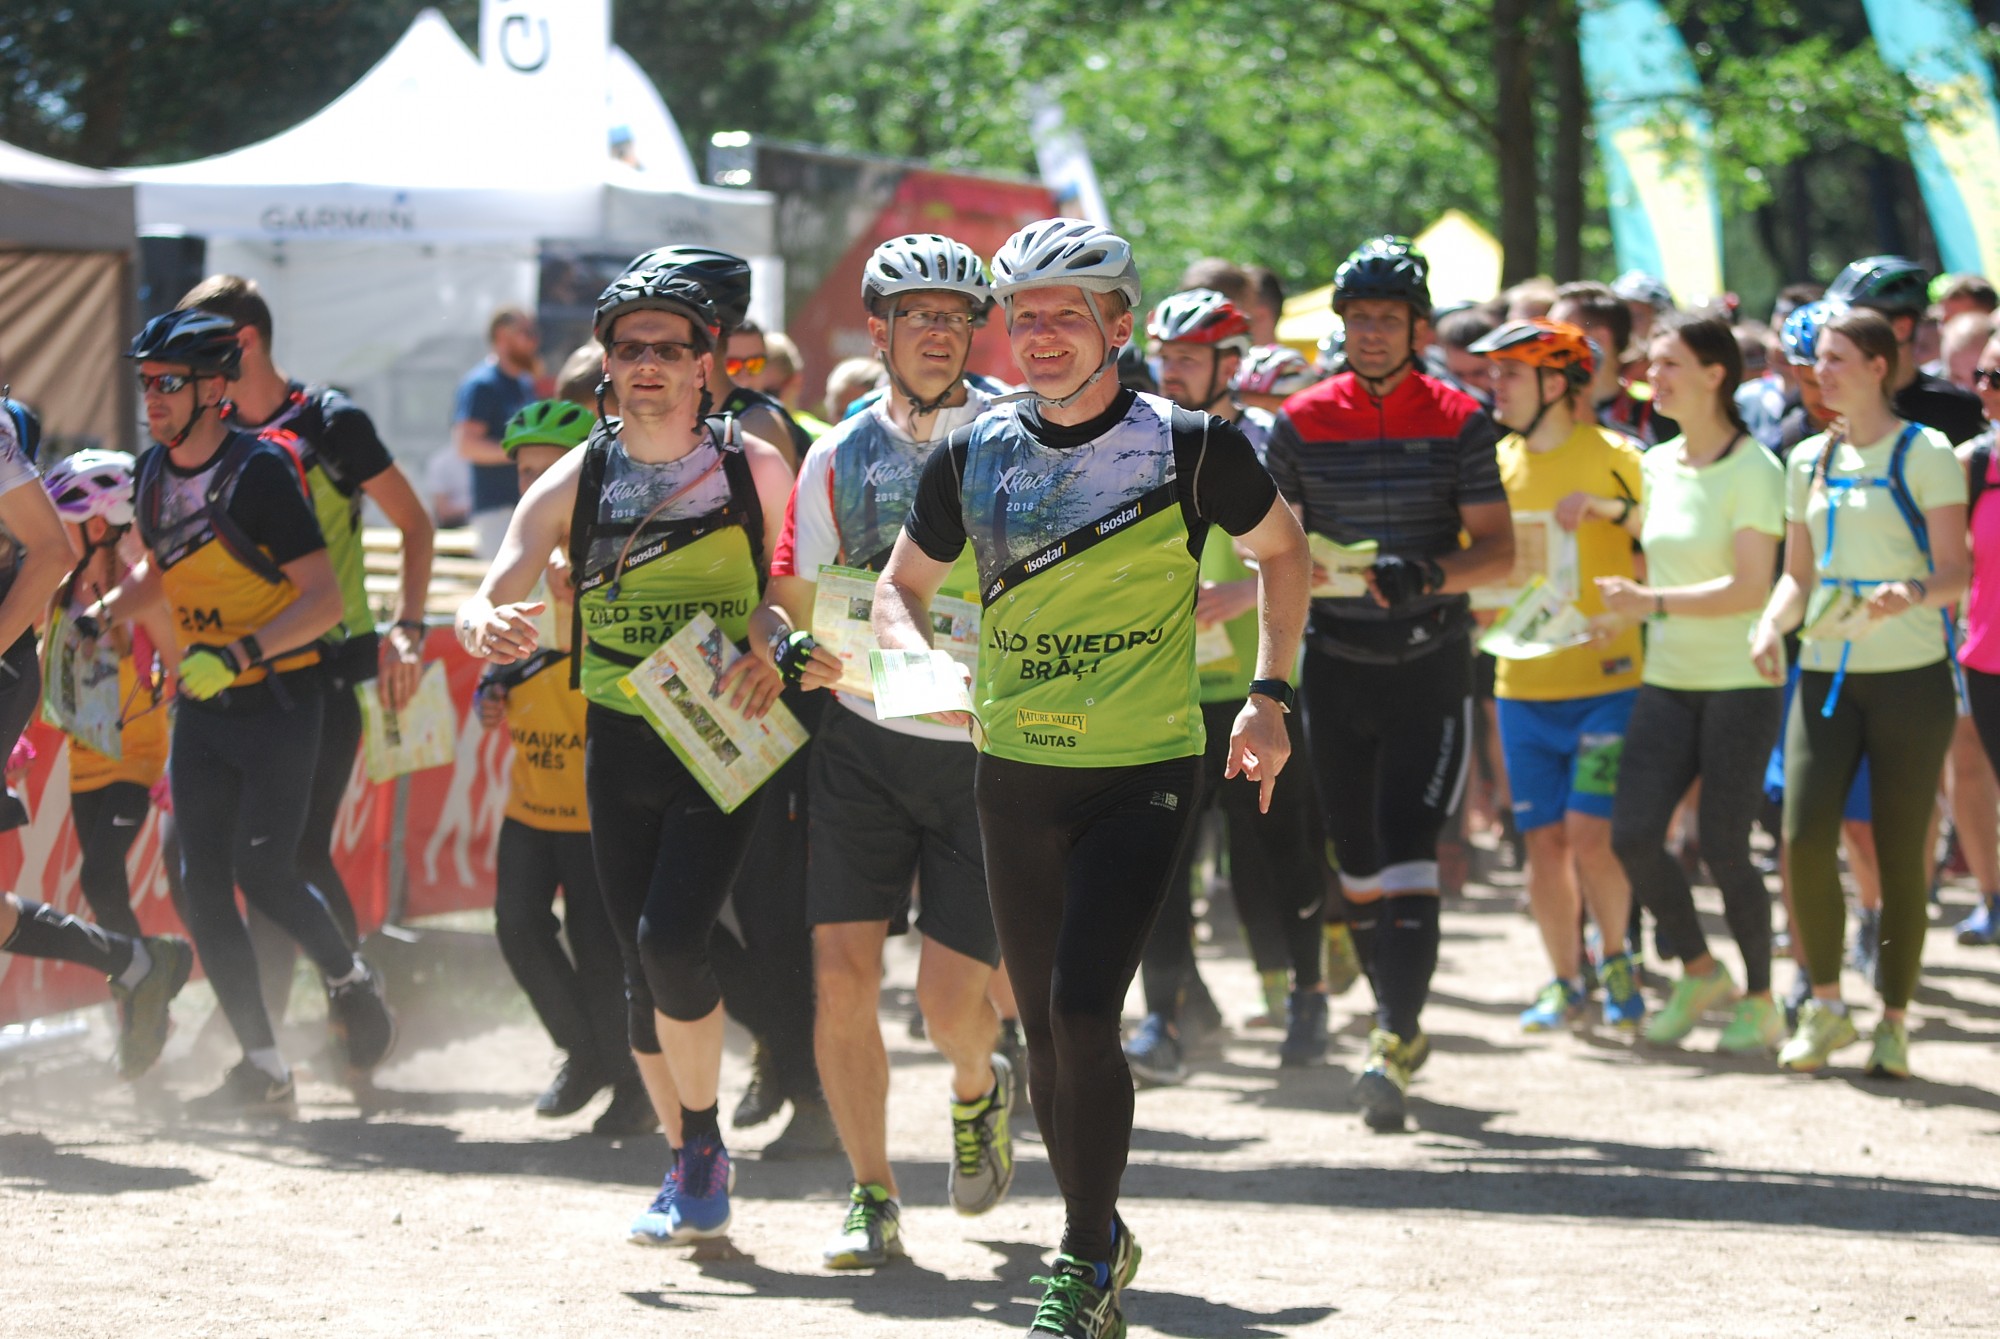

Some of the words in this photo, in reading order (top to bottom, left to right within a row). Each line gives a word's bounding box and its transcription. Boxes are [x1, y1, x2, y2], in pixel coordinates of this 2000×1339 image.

[259, 204, 415, 234] GARMIN
[874, 492, 901, 503] 2018
[611, 509, 637, 519] 2018
[1006, 502, 1034, 513] 2018
[624, 622, 682, 644] BRĀ
[1018, 709, 1050, 726] NATURE
[1051, 714, 1085, 730] VALLEY
[1023, 731, 1077, 748] TAUTAS
